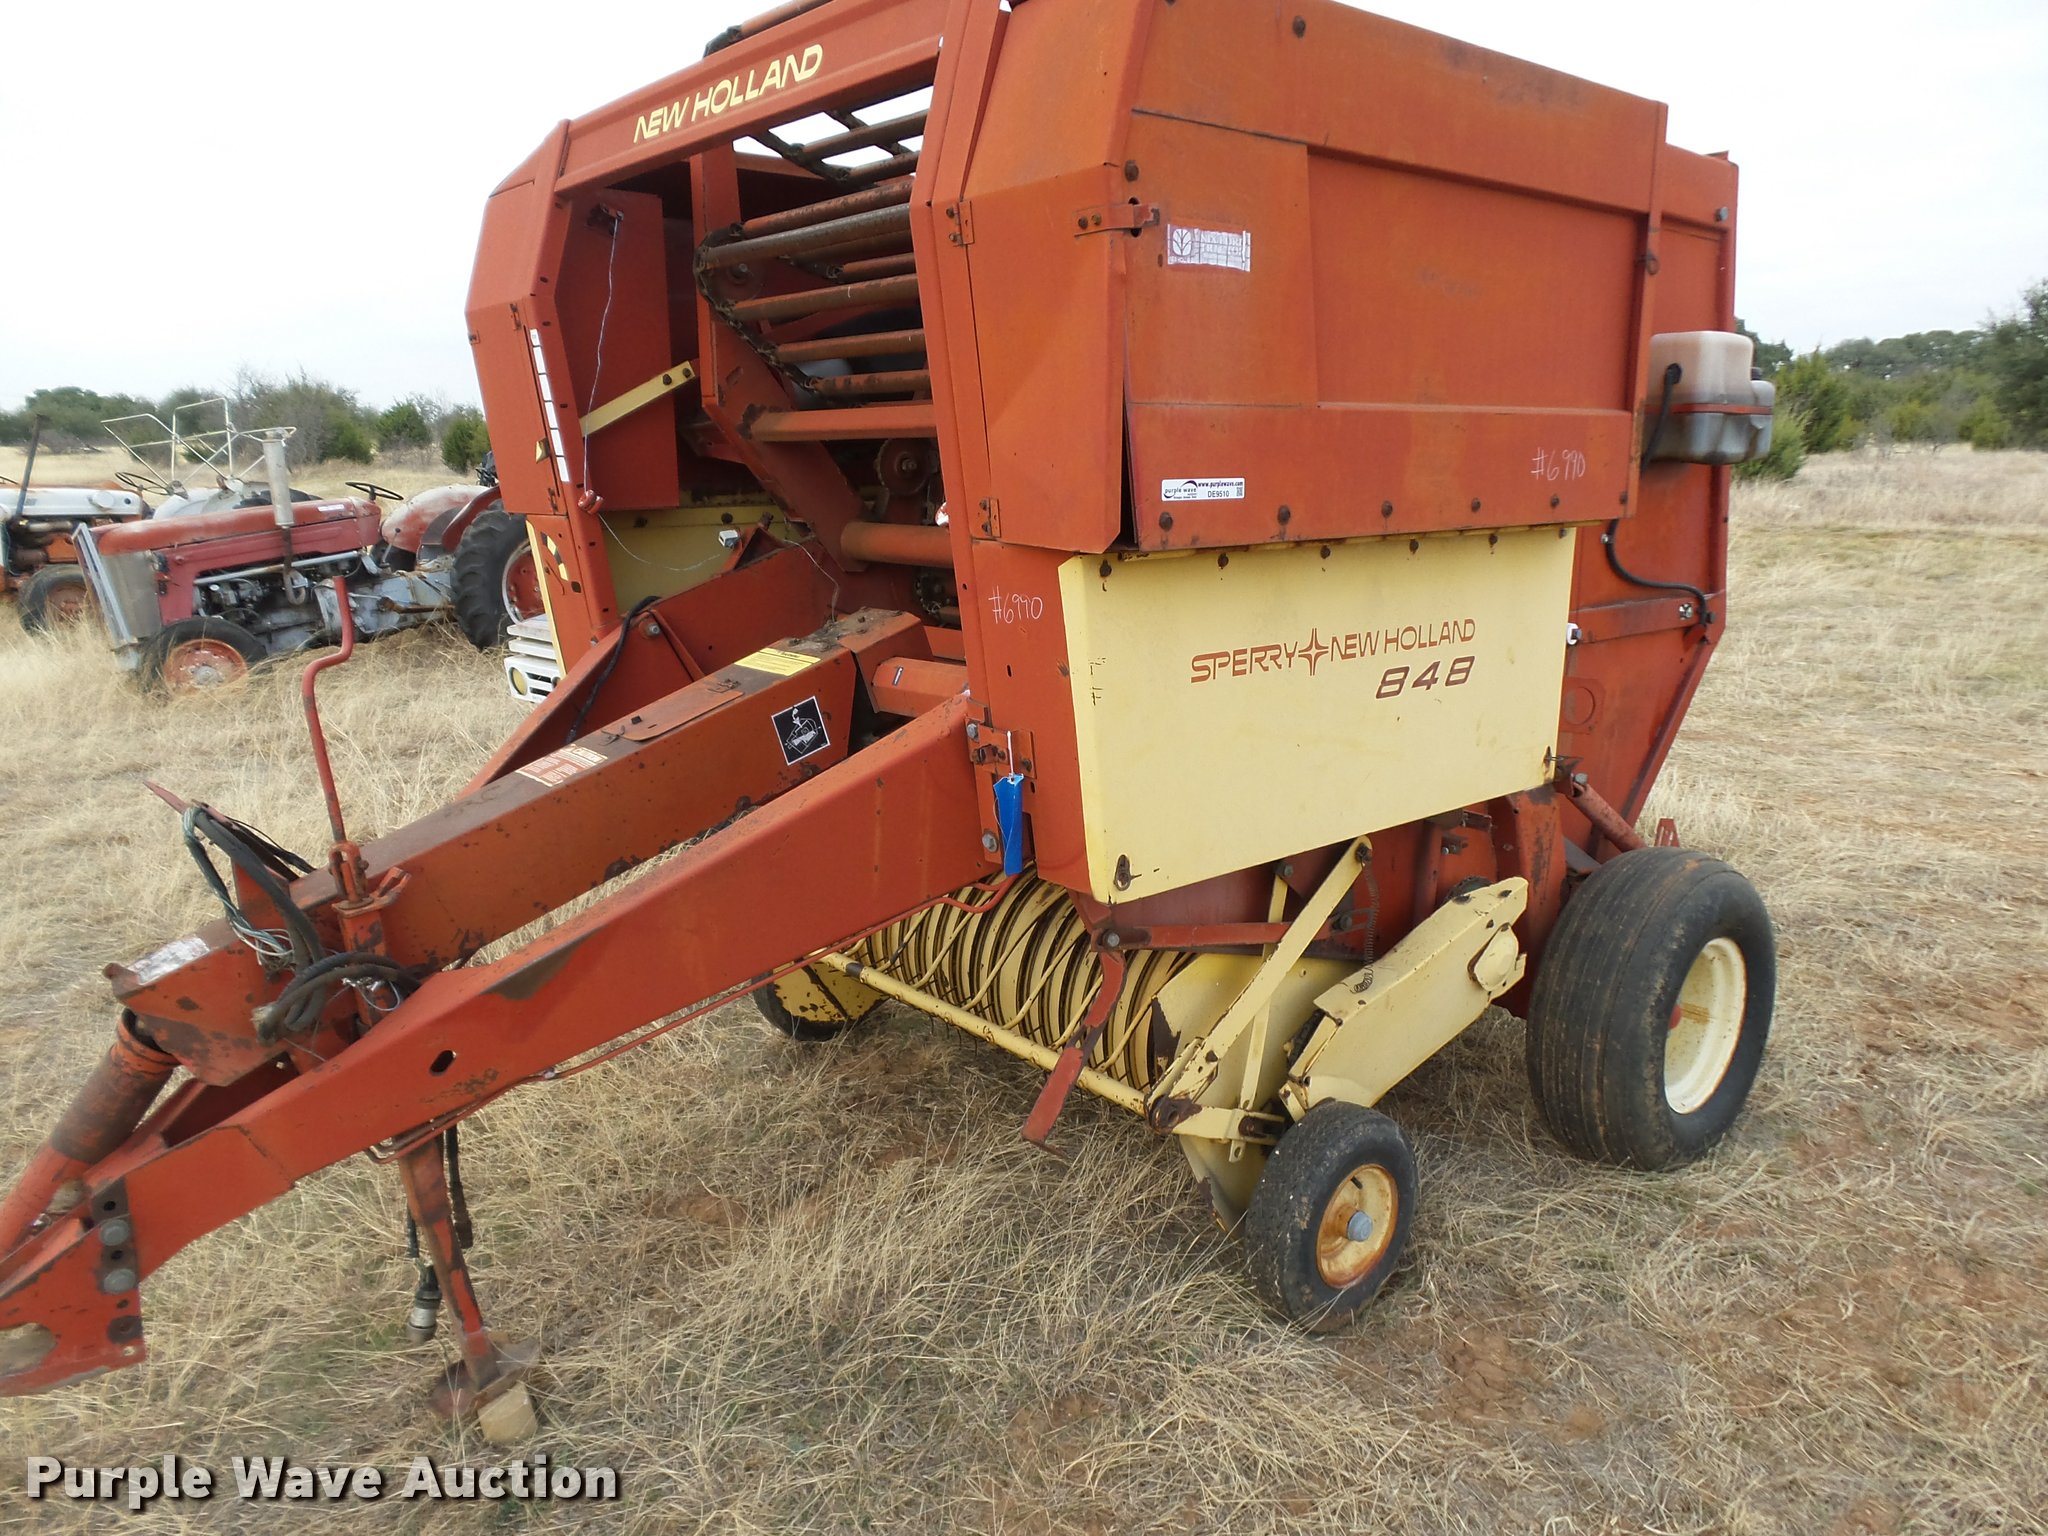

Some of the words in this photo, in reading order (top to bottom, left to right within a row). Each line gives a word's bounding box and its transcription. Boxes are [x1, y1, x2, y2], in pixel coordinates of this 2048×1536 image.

[633, 97, 690, 143] NEW
[691, 44, 823, 121] HOLLAND
[1198, 481, 1243, 489] www.purplewave.com
[1207, 490, 1230, 498] DE9510
[1191, 641, 1298, 684] SPERRY
[1330, 630, 1380, 662] NEW
[1384, 618, 1476, 654] HOLLAND
[1375, 655, 1476, 700] 848
